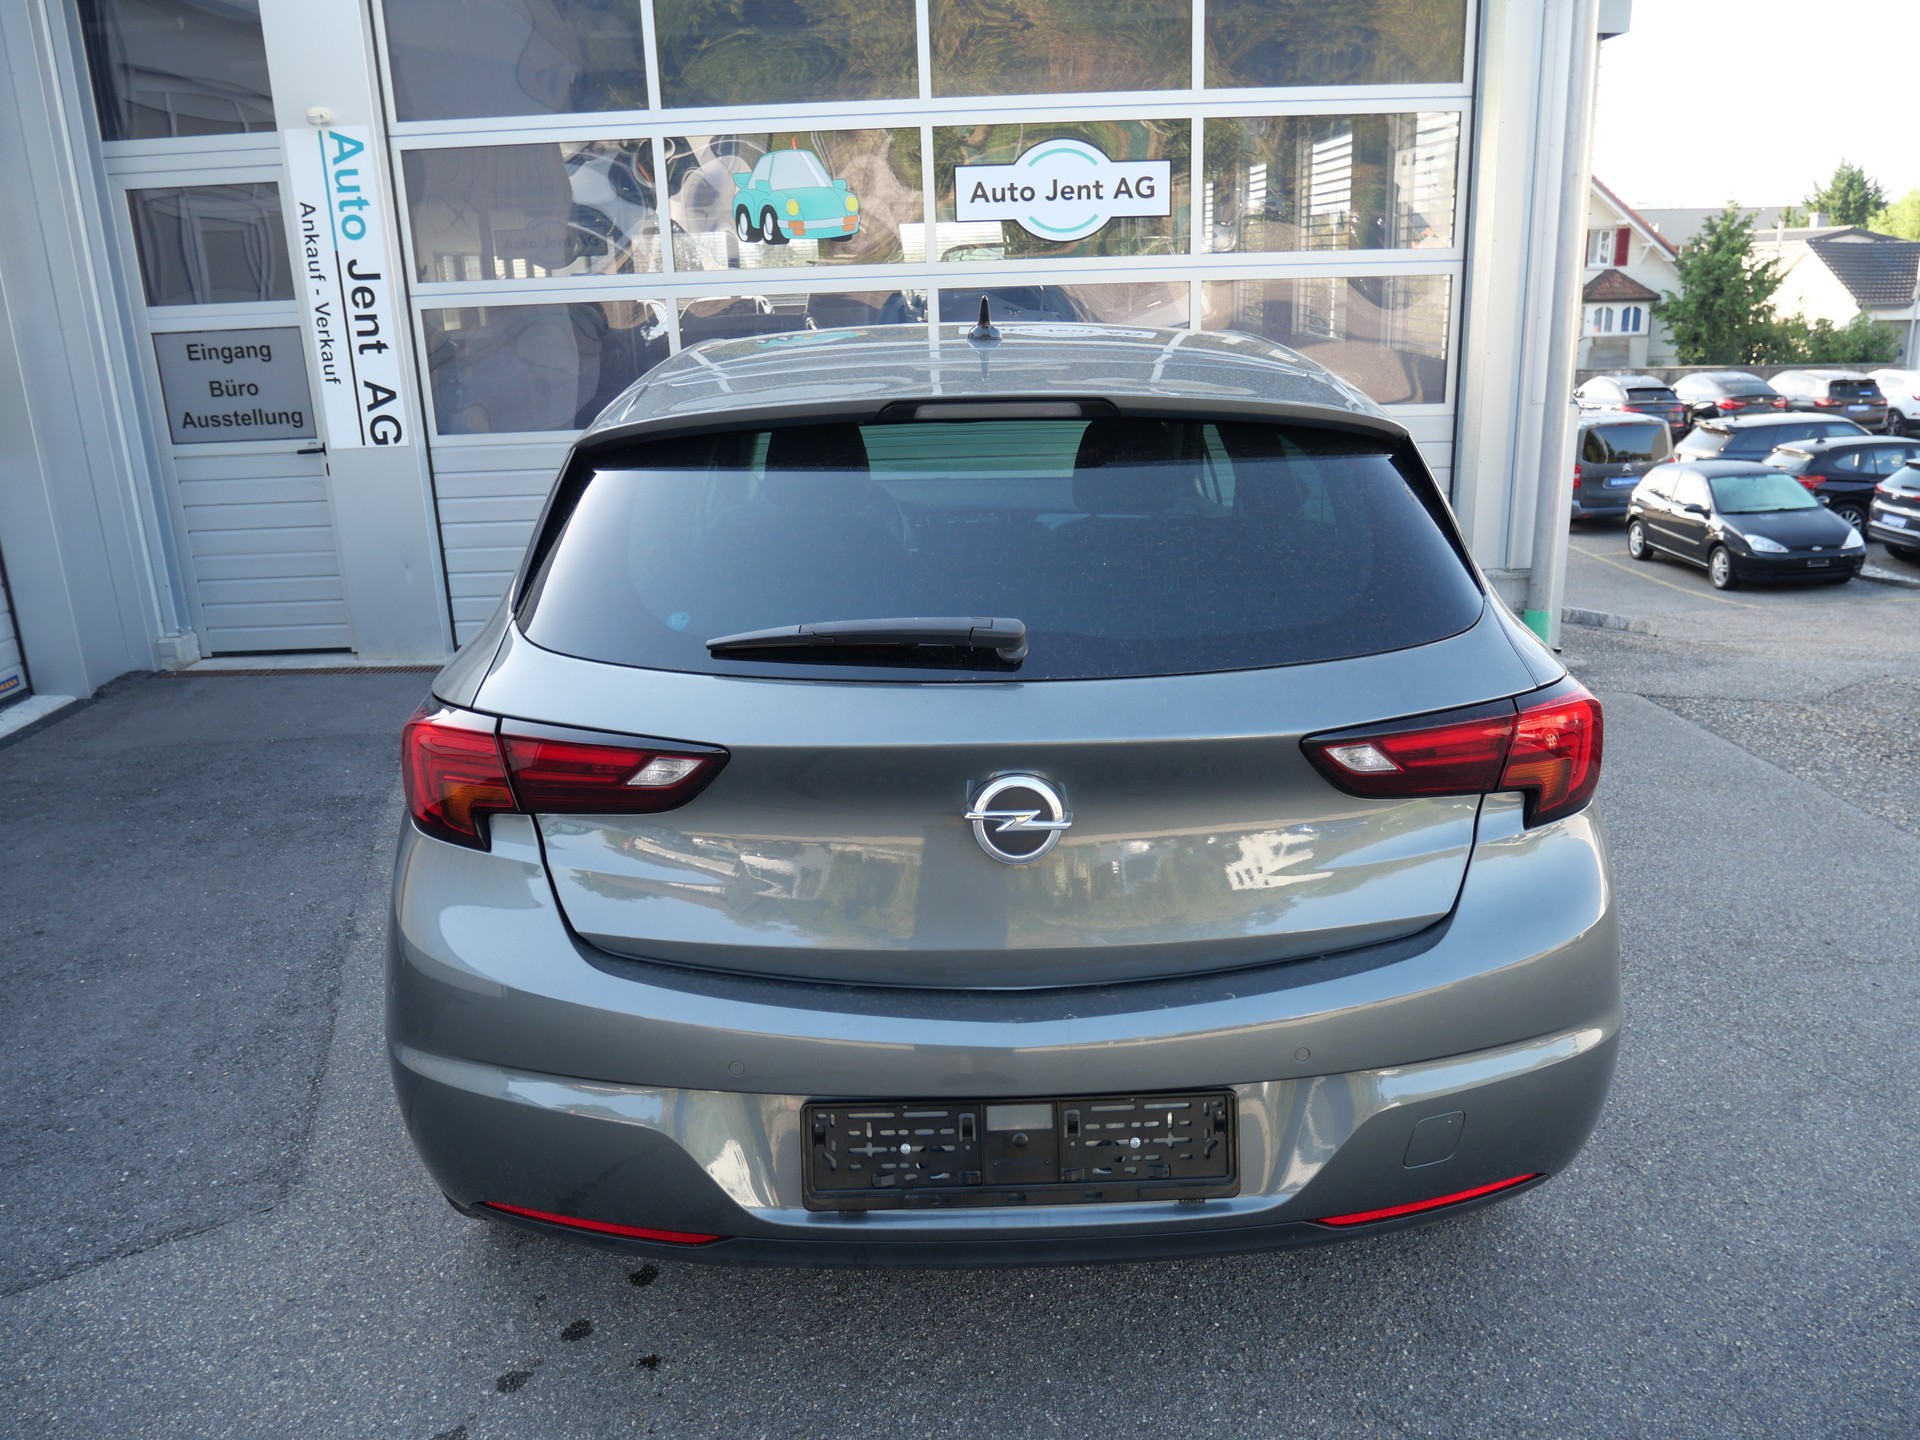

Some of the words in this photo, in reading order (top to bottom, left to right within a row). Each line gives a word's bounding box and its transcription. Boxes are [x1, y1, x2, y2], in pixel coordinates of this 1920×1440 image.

[329, 131, 370, 241] Auto
[970, 181, 1036, 203] Auto
[1045, 179, 1103, 201] Jent
[1113, 176, 1155, 199] AG
[299, 202, 326, 281] Ankauf
[314, 302, 341, 384] Verkauf
[347, 259, 389, 355] Jent
[186, 343, 272, 364] Eingang
[209, 380, 259, 398] Büro
[182, 408, 304, 429] Ausstellung
[363, 380, 403, 446] AG
